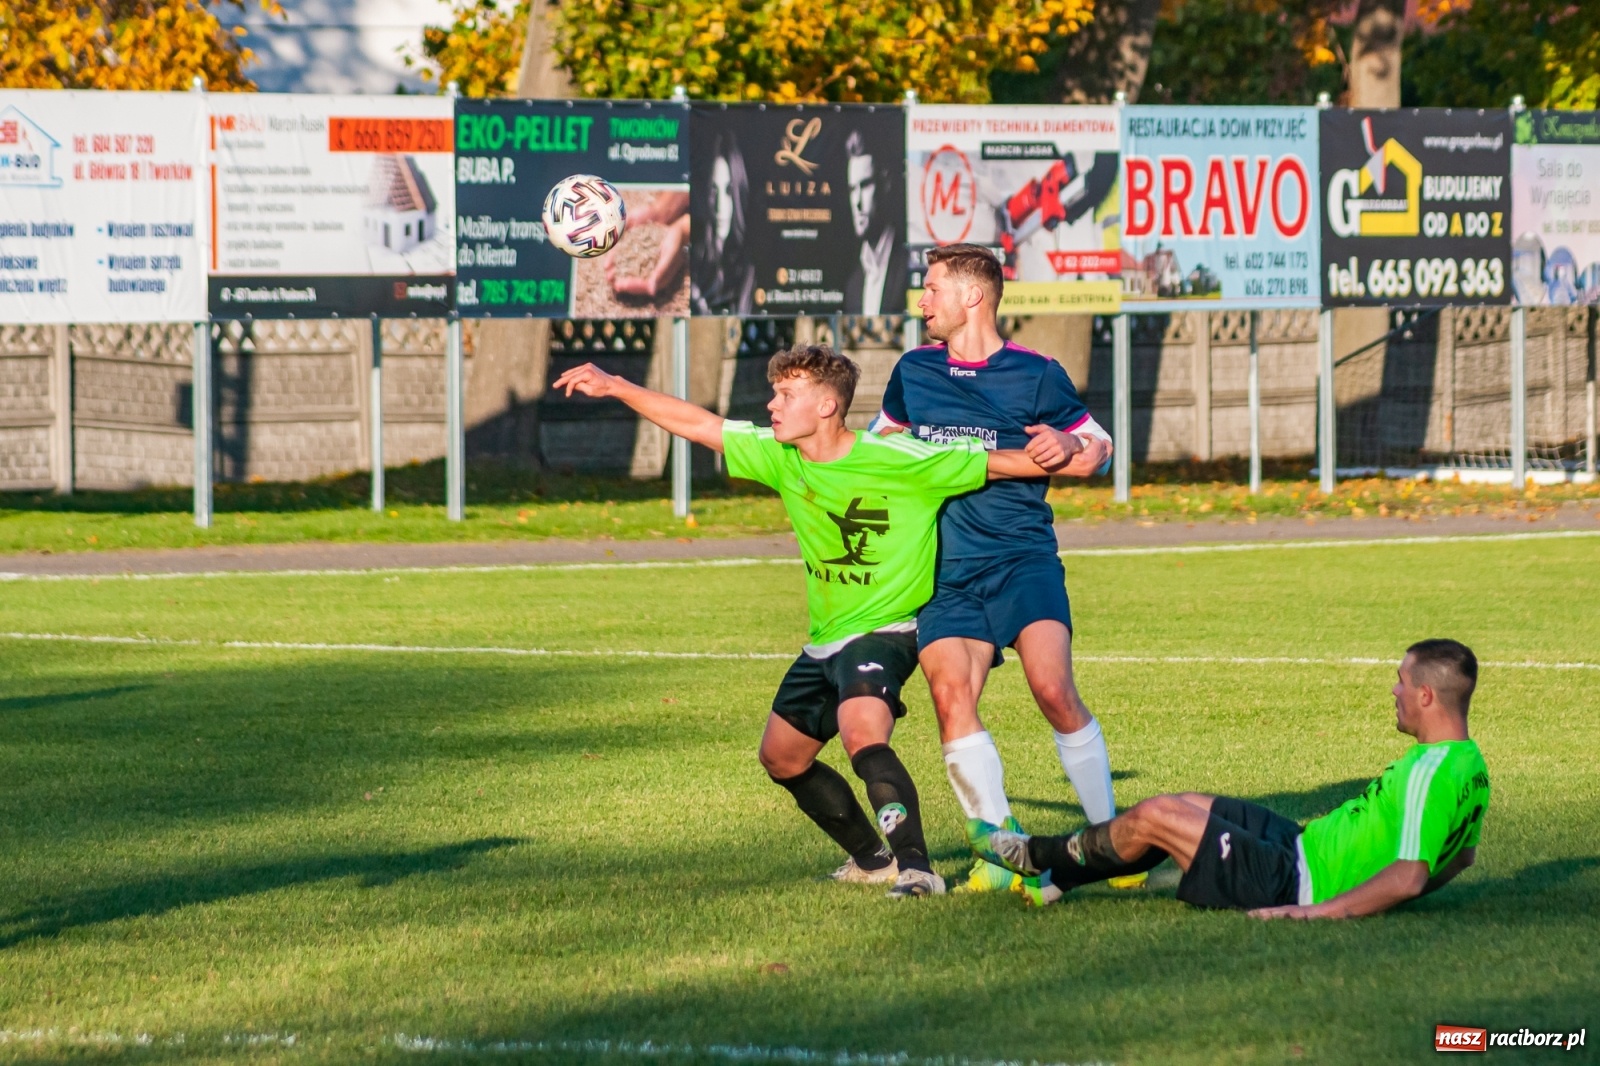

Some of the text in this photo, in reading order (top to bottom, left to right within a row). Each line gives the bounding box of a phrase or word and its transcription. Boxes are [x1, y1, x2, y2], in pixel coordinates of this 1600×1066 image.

[457, 114, 594, 151] EKO-PELLET
[986, 119, 1040, 133] TECHNIKA
[1043, 119, 1116, 134] DIAMENTOWA
[1129, 113, 1307, 141] RESTAURACJA DOM PRZYJĘĆ
[457, 156, 500, 184] BUBA
[1538, 158, 1583, 177] Sala do
[766, 181, 831, 196] LUIZA
[1124, 156, 1310, 239] BRAVO
[1423, 176, 1503, 200] BUDUJEMY
[458, 215, 508, 243] Możliwy
[1423, 211, 1503, 238] OD A DO Z
[458, 243, 517, 267] do klienta
[1245, 252, 1264, 269] 602
[1267, 252, 1286, 269] 744
[1289, 252, 1308, 269] 173
[1245, 278, 1264, 295] 606
[1267, 277, 1287, 295] 270
[1328, 256, 1505, 298] tel. 665 092 363
[457, 279, 479, 305] tel.
[1059, 293, 1114, 304] ELEKTRYKA
[825, 566, 879, 586] BANK
